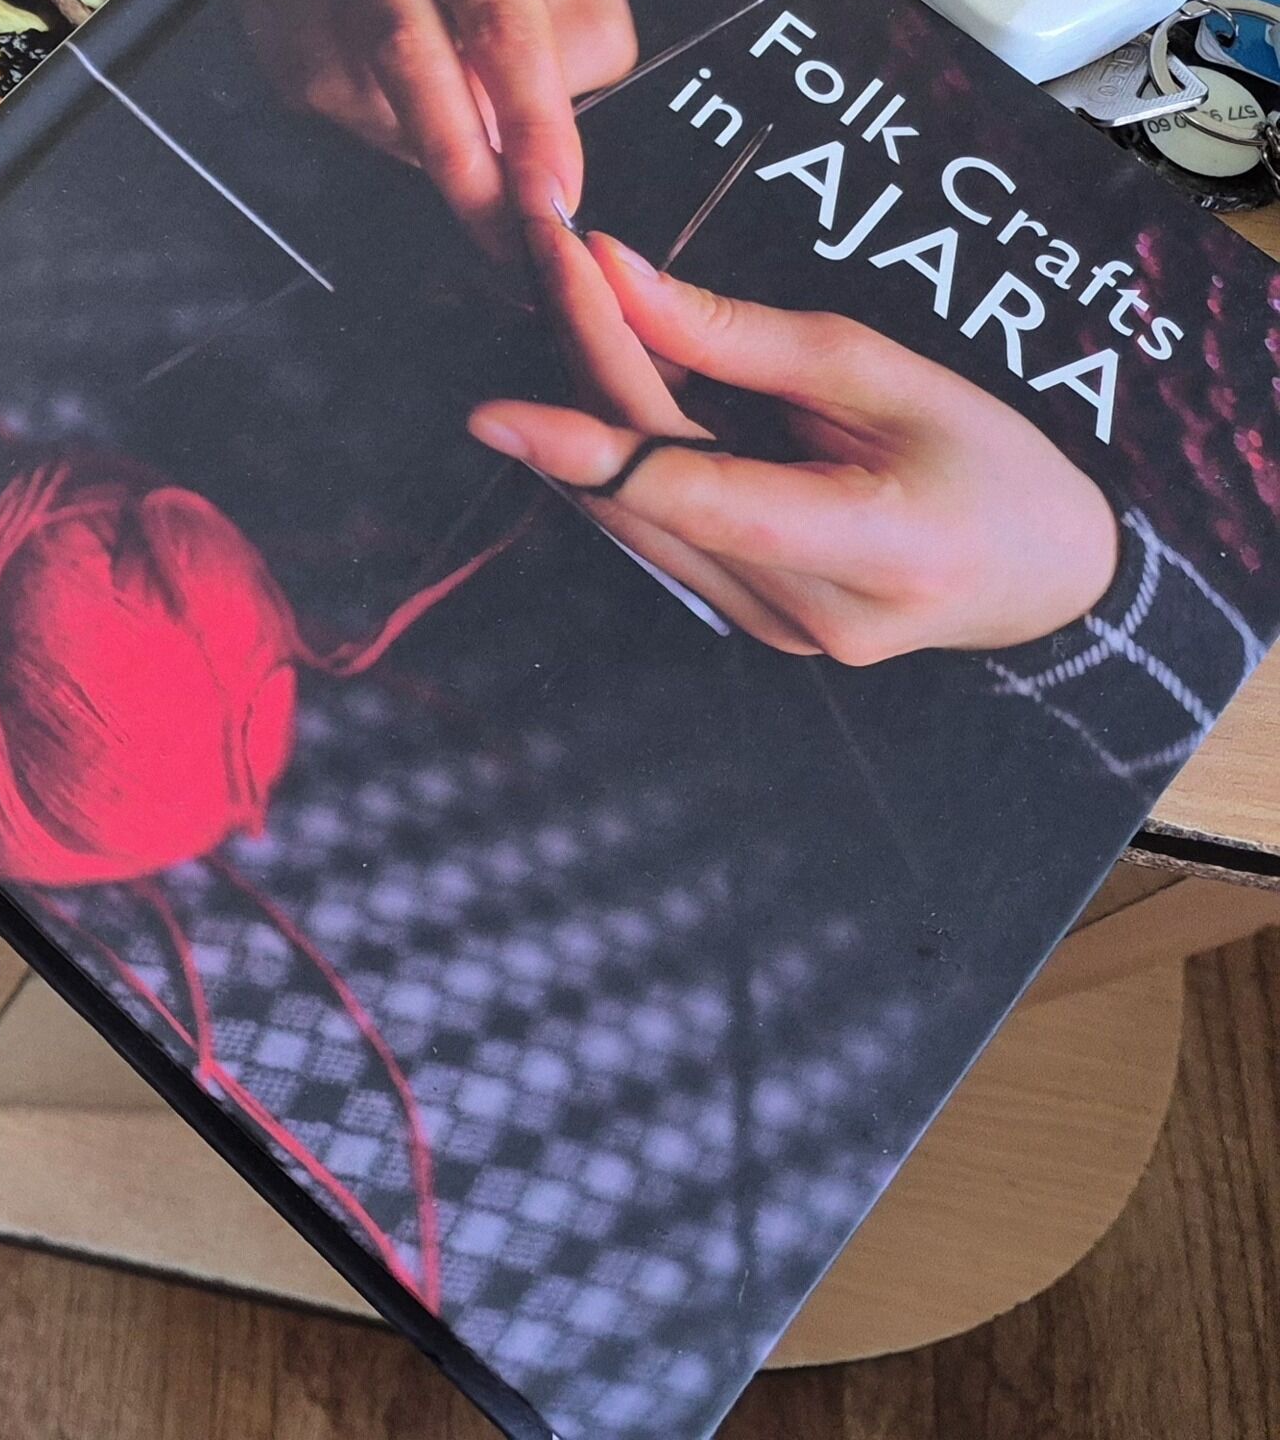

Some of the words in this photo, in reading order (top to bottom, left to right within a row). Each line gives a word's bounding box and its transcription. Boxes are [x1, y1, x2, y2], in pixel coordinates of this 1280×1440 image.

[749, 10, 920, 165] Folk
[940, 155, 1186, 361] Crafts
[1148, 120, 1171, 134] 60
[1228, 105, 1258, 121] 577
[667, 67, 744, 147] in
[754, 139, 1120, 445] AJARA
